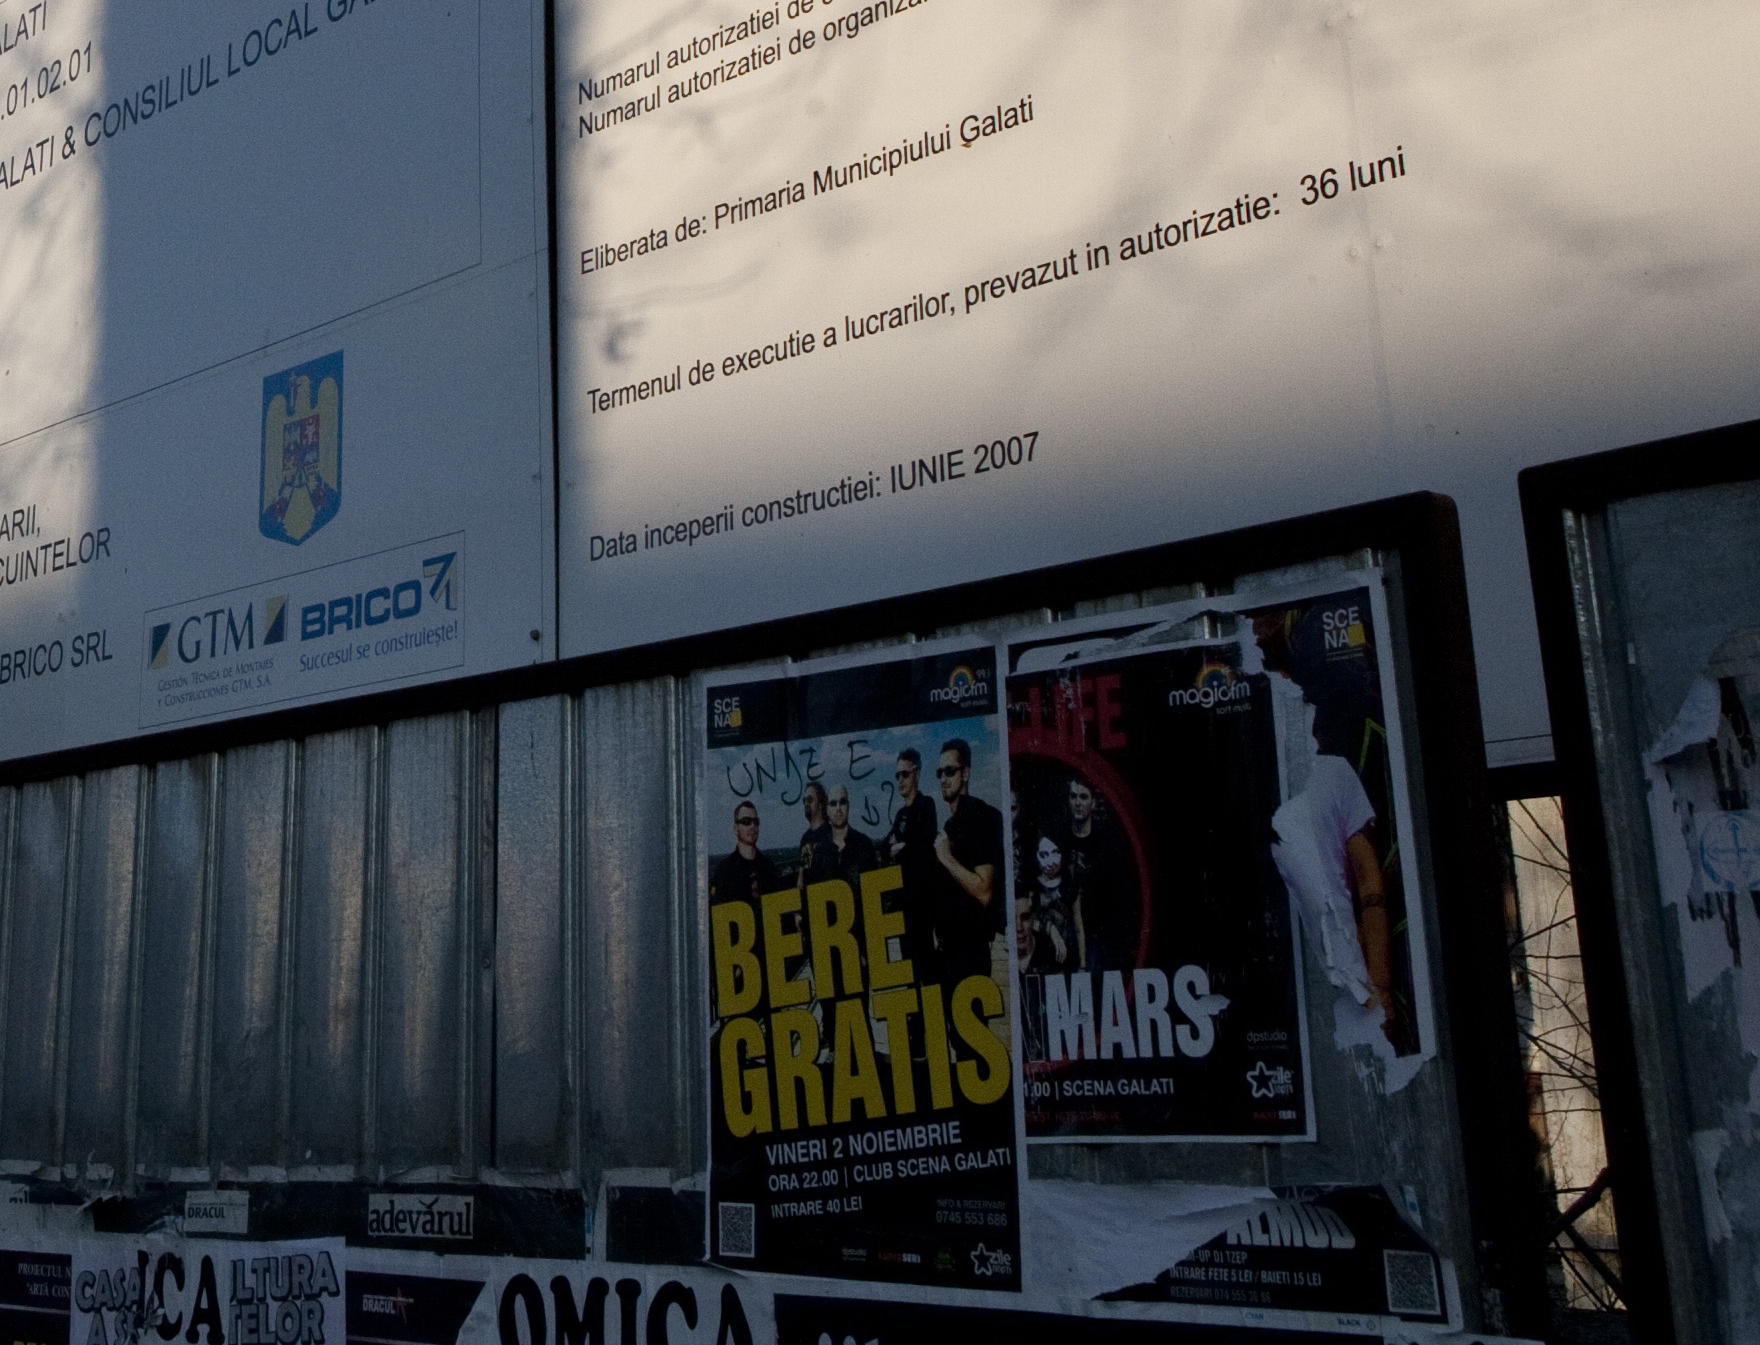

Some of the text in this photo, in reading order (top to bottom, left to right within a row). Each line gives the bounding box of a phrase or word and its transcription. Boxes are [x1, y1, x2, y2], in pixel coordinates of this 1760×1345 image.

[61, 124, 77, 161] &
[83, 53, 220, 148] CONSILIUL
[226, 1, 319, 79] LOCAL
[578, 50, 660, 105] Numarul
[666, 1, 780, 70] autorizatiei
[580, 93, 1034, 276] Eliberata de: Primaria Municipiului Galati
[586, 144, 1406, 415] Termenul de executie a lucrarilor, prevazut in autorizatie: 36 luni
[589, 430, 1040, 562] Data inceperii constructiei: IUNIE 2007
[177, 602, 254, 664] GTM
[300, 579, 422, 642] BRICO
[300, 644, 354, 673] Succesul
[356, 643, 370, 660] se
[711, 865, 914, 1017] BERE
[1043, 964, 1219, 1061] MARS
[720, 975, 1012, 1138] GRATIS
[1062, 1077, 1175, 1097] SCENA GALATI
[765, 1120, 962, 1167] VINERI 2 NOIEMBRIE
[768, 1147, 1011, 1193] ORA 22.00 CLUB SCENA GALATI
[188, 1206, 226, 1220] DRACUL
[369, 1197, 473, 1238] adevărul
[771, 1195, 863, 1219] INTRARE 40 LEI
[362, 1297, 396, 1315] DRACUL
[1170, 1266, 1206, 1281] INTRARE
[1208, 1267, 1229, 1282] FETE
[1239, 1269, 1253, 1283] LEI
[1260, 1270, 1290, 1285] BAIETI
[1293, 1271, 1304, 1286] 15
[1306, 1272, 1322, 1287] LEI
